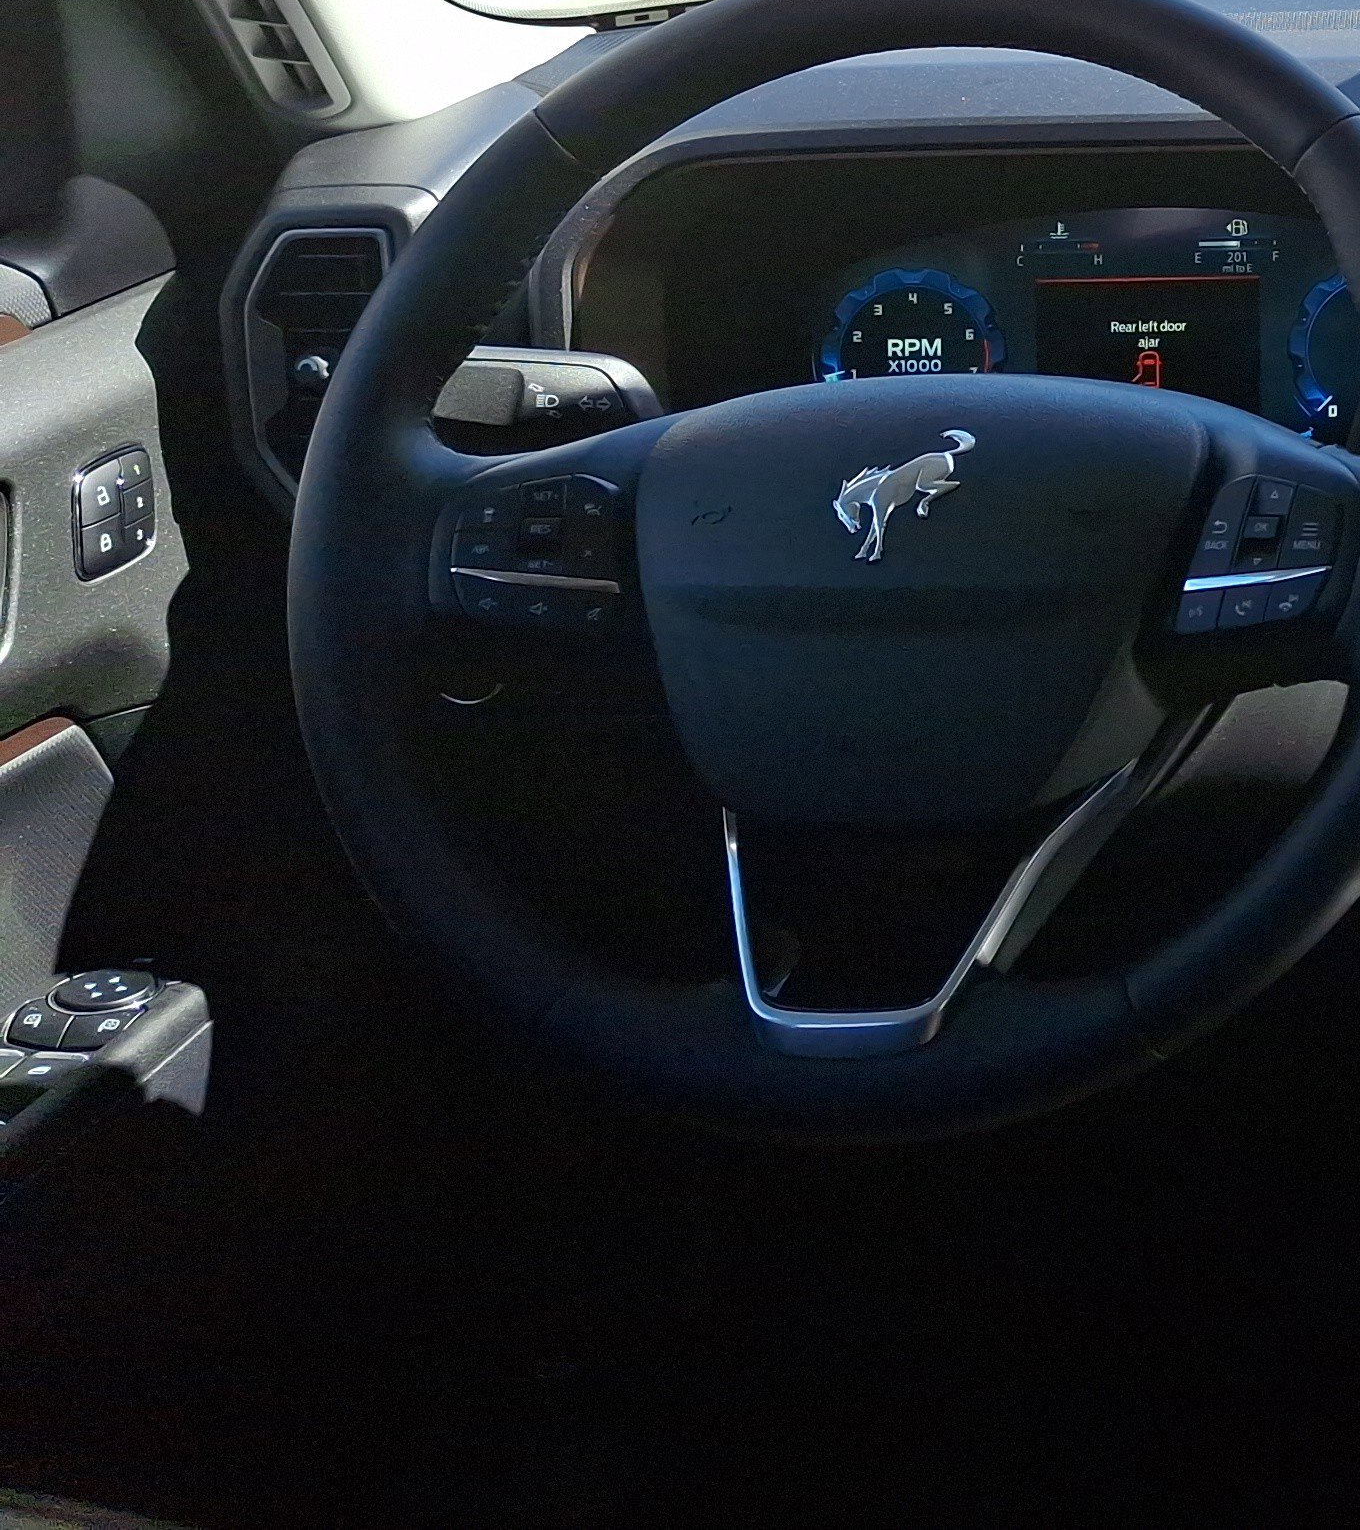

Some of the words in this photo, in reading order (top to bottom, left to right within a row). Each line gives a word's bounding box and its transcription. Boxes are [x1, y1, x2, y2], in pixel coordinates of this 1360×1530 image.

[1016, 255, 1024, 267] C
[1093, 255, 1103, 266] H
[1194, 252, 1202, 264] E
[1226, 251, 1248, 263] 201
[1272, 251, 1280, 263] F
[908, 292, 918, 305] 4
[873, 304, 883, 316] 3
[943, 303, 953, 315] 5
[1110, 321, 1137, 333] Rear
[1138, 320, 1159, 333] left
[1160, 320, 1187, 332] door
[852, 330, 863, 343] 2
[965, 328, 975, 341] 6
[887, 338, 942, 357] RPM
[1137, 336, 1160, 350] ajar
[888, 359, 942, 373] X1000
[1328, 405, 1338, 418] 0
[133, 464, 141, 476] 1
[136, 496, 144, 509] 2
[136, 528, 143, 541] 3
[1292, 540, 1321, 550] MENU
